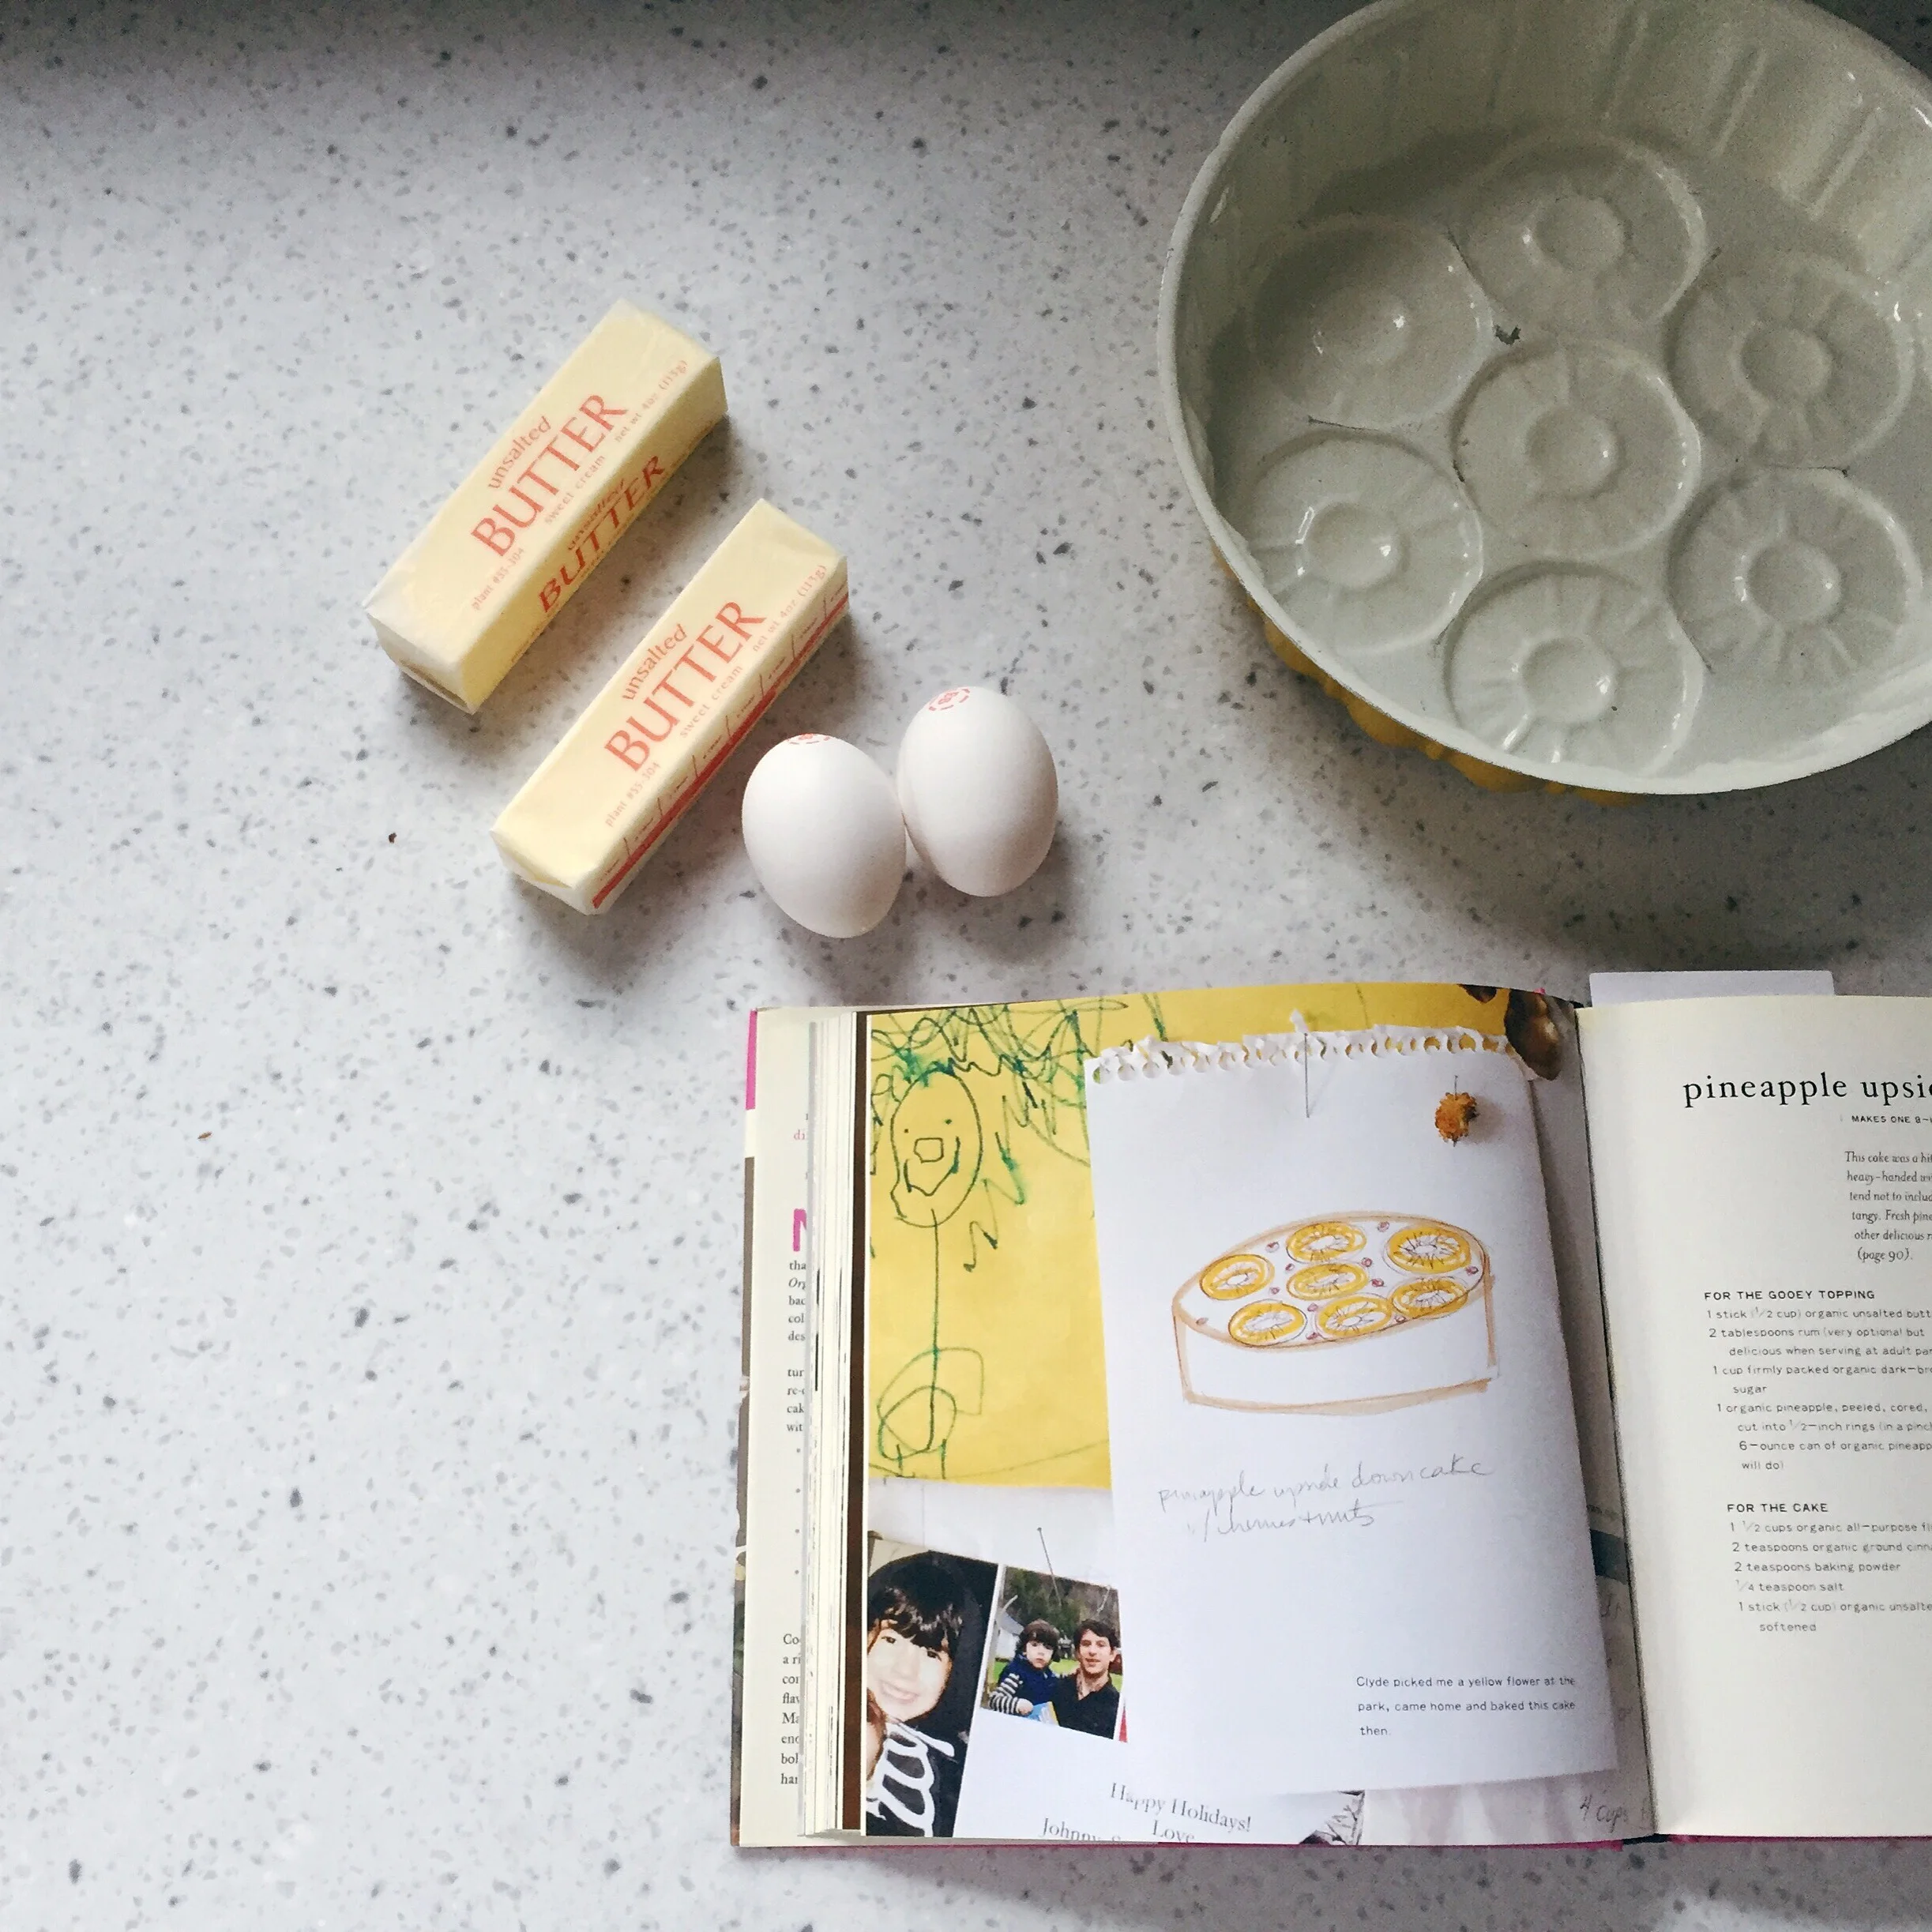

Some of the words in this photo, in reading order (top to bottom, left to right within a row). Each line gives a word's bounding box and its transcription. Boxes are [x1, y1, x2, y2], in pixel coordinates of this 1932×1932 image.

[488, 415, 551, 489] unsalted
[471, 394, 628, 556] BUTTER
[544, 491, 575, 524] sweet
[575, 456, 606, 489] cream
[539, 456, 665, 613] BUTTER
[622, 623, 688, 701] unsalted
[603, 601, 767, 772] BUTTER
[680, 702, 710, 738] sweet
[712, 665, 743, 701] cream
[1683, 1072, 1847, 1107] pineapple
[1844, 1151, 1865, 1163] This
[1868, 1151, 1889, 1163] cake
[1847, 1171, 1917, 1186] heavy-handed
[1850, 1190, 1870, 1201] tend
[1874, 1192, 1889, 1201] not
[1893, 1191, 1901, 1201] to
[1852, 1211, 1881, 1224] tangy.
[1885, 1209, 1910, 1220] Fresh
[1855, 1229, 1880, 1240] other
[1882, 1229, 1924, 1240] delicious
[1857, 1246, 1885, 1264] (page
[1889, 1246, 1913, 1262] 90).
[1705, 1291, 1731, 1300] FOR
[1737, 1291, 1763, 1300] THE
[1768, 1291, 1813, 1299] GOOEY
[1818, 1291, 1875, 1299] TOPPING
[1805, 1310, 1848, 1320] organic
[1852, 1310, 1903, 1318] unsalted
[1709, 1328, 1716, 1338] 2
[1721, 1328, 1795, 1338] tablespoons
[1729, 1347, 1782, 1355] delicious
[1786, 1347, 1815, 1355] when
[1819, 1347, 1861, 1357] serving
[1866, 1347, 1877, 1355] at
[1883, 1346, 1911, 1355] adult
[1723, 1366, 1742, 1375] cup
[1747, 1365, 1782, 1375] firmly
[1786, 1365, 1829, 1374] packed
[1832, 1365, 1877, 1375] organic
[1733, 1385, 1767, 1395] sugar
[1726, 1403, 1772, 1413] organic
[1890, 1402, 1927, 1412] cored,
[787, 1422, 803, 1432] wit
[1738, 1423, 1757, 1431] cut
[1762, 1422, 1786, 1431] into
[1846, 1423, 1875, 1433] rings
[1739, 1441, 1795, 1451] 6-ounce
[1825, 1441, 1836, 1450] of
[1840, 1441, 1884, 1452] organic
[1742, 1461, 1760, 1470] will
[1760, 1503, 1787, 1512] THE
[1793, 1503, 1829, 1512] CAKE
[1796, 1524, 1842, 1534] organic
[1847, 1523, 1917, 1533] all-purpose
[1732, 1542, 1740, 1552] 2
[1745, 1543, 1809, 1552] teaspoons
[1813, 1543, 1858, 1553] organic
[1862, 1543, 1902, 1553] ground
[1735, 1562, 1742, 1572] 2
[1746, 1562, 1811, 1572] teaspoons
[1815, 1562, 1854, 1573] baking
[1859, 1562, 1901, 1572] powder
[1759, 1583, 1816, 1592] teaspoon
[1820, 1582, 1844, 1592] salt
[1749, 1602, 1780, 1612] stick
[1840, 1603, 1885, 1614] organic
[1760, 1622, 1817, 1632] softened
[783, 1656, 789, 1664] a
[1356, 1676, 1389, 1687] Clyde
[1393, 1676, 1432, 1687] picked
[1468, 1676, 1502, 1689] yellow
[1507, 1675, 1540, 1686] flower
[1544, 1677, 1554, 1686] at
[1559, 1676, 1576, 1686] the
[1358, 1701, 1390, 1712] park,
[1394, 1703, 1426, 1712] came
[1430, 1701, 1461, 1711] home
[1466, 1701, 1487, 1711] and
[1490, 1700, 1524, 1711] baked
[1528, 1701, 1549, 1711] this
[1552, 1701, 1577, 1710] cake
[1360, 1726, 1391, 1736] then.
[1110, 1782, 1166, 1816] Happy
[1171, 1797, 1252, 1834] Holidays!
[1152, 1819, 1195, 1843] Love
